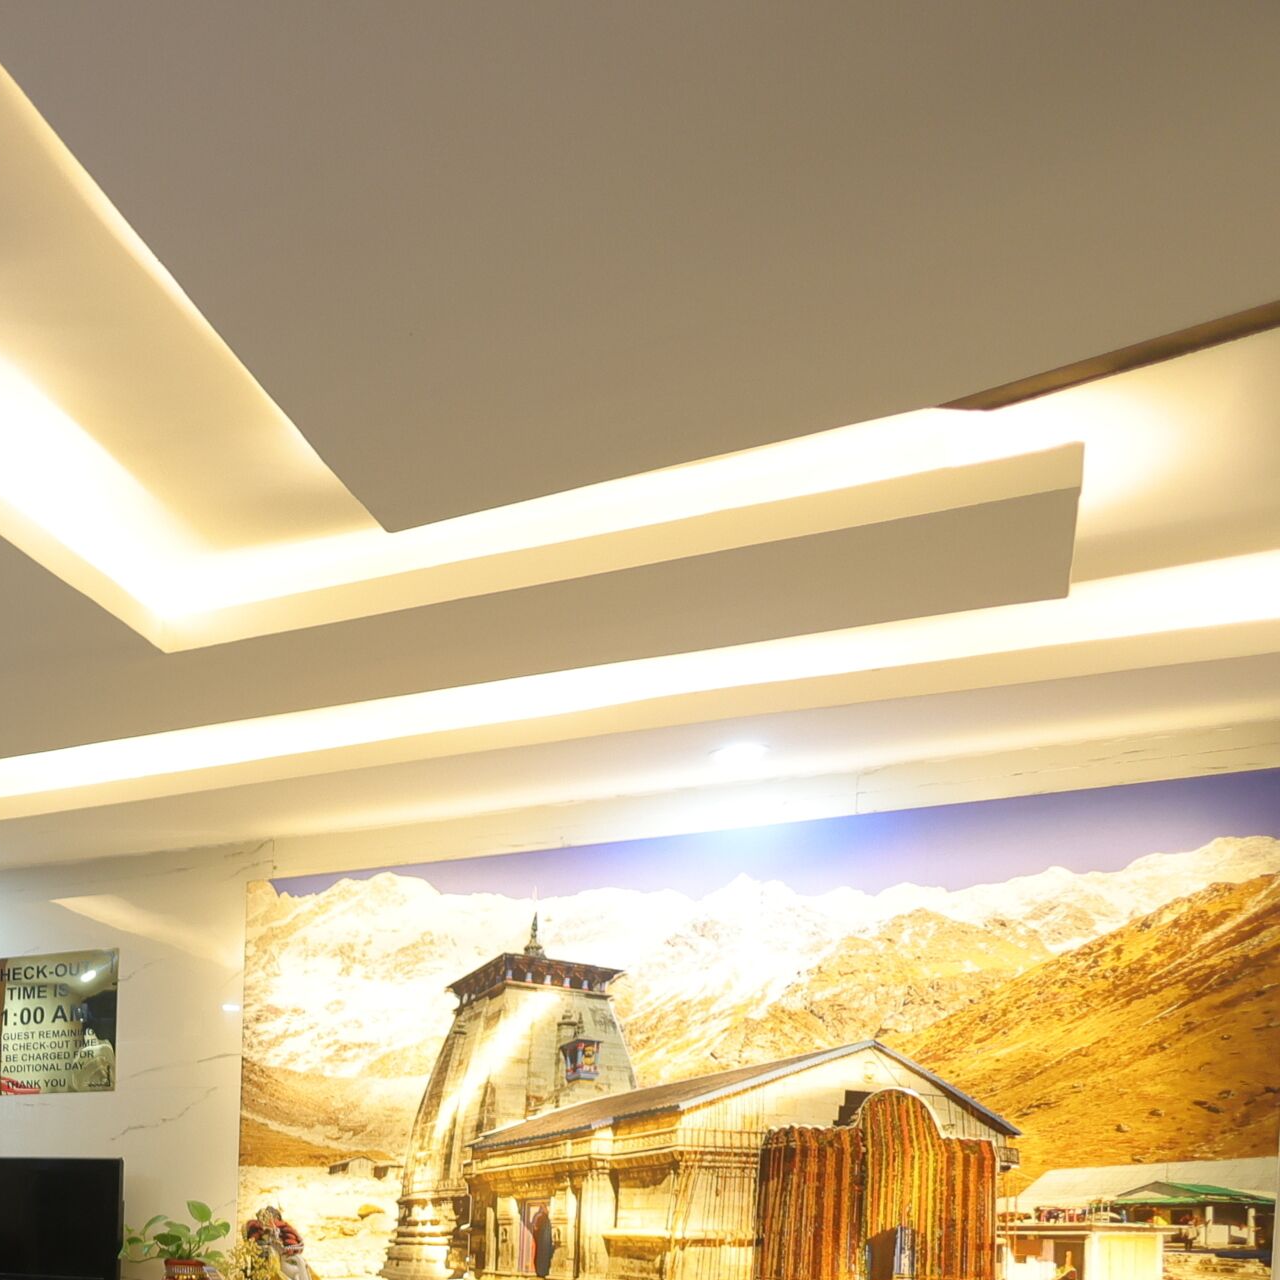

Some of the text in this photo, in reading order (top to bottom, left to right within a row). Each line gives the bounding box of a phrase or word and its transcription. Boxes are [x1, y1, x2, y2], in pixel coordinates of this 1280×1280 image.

[7, 983, 69, 1000] TIME IS
[3, 1032, 35, 1040] GUEST
[12, 1040, 69, 1051] CHECK-OUT
[74, 1038, 96, 1048] TIME
[6, 1054, 18, 1062] BE
[22, 1051, 70, 1061] CHARGED
[74, 1050, 94, 1058] FOR
[3, 1063, 61, 1073] ADDITIONAL
[65, 1062, 84, 1071] DAY
[6, 1078, 66, 1089] THANK YOU
